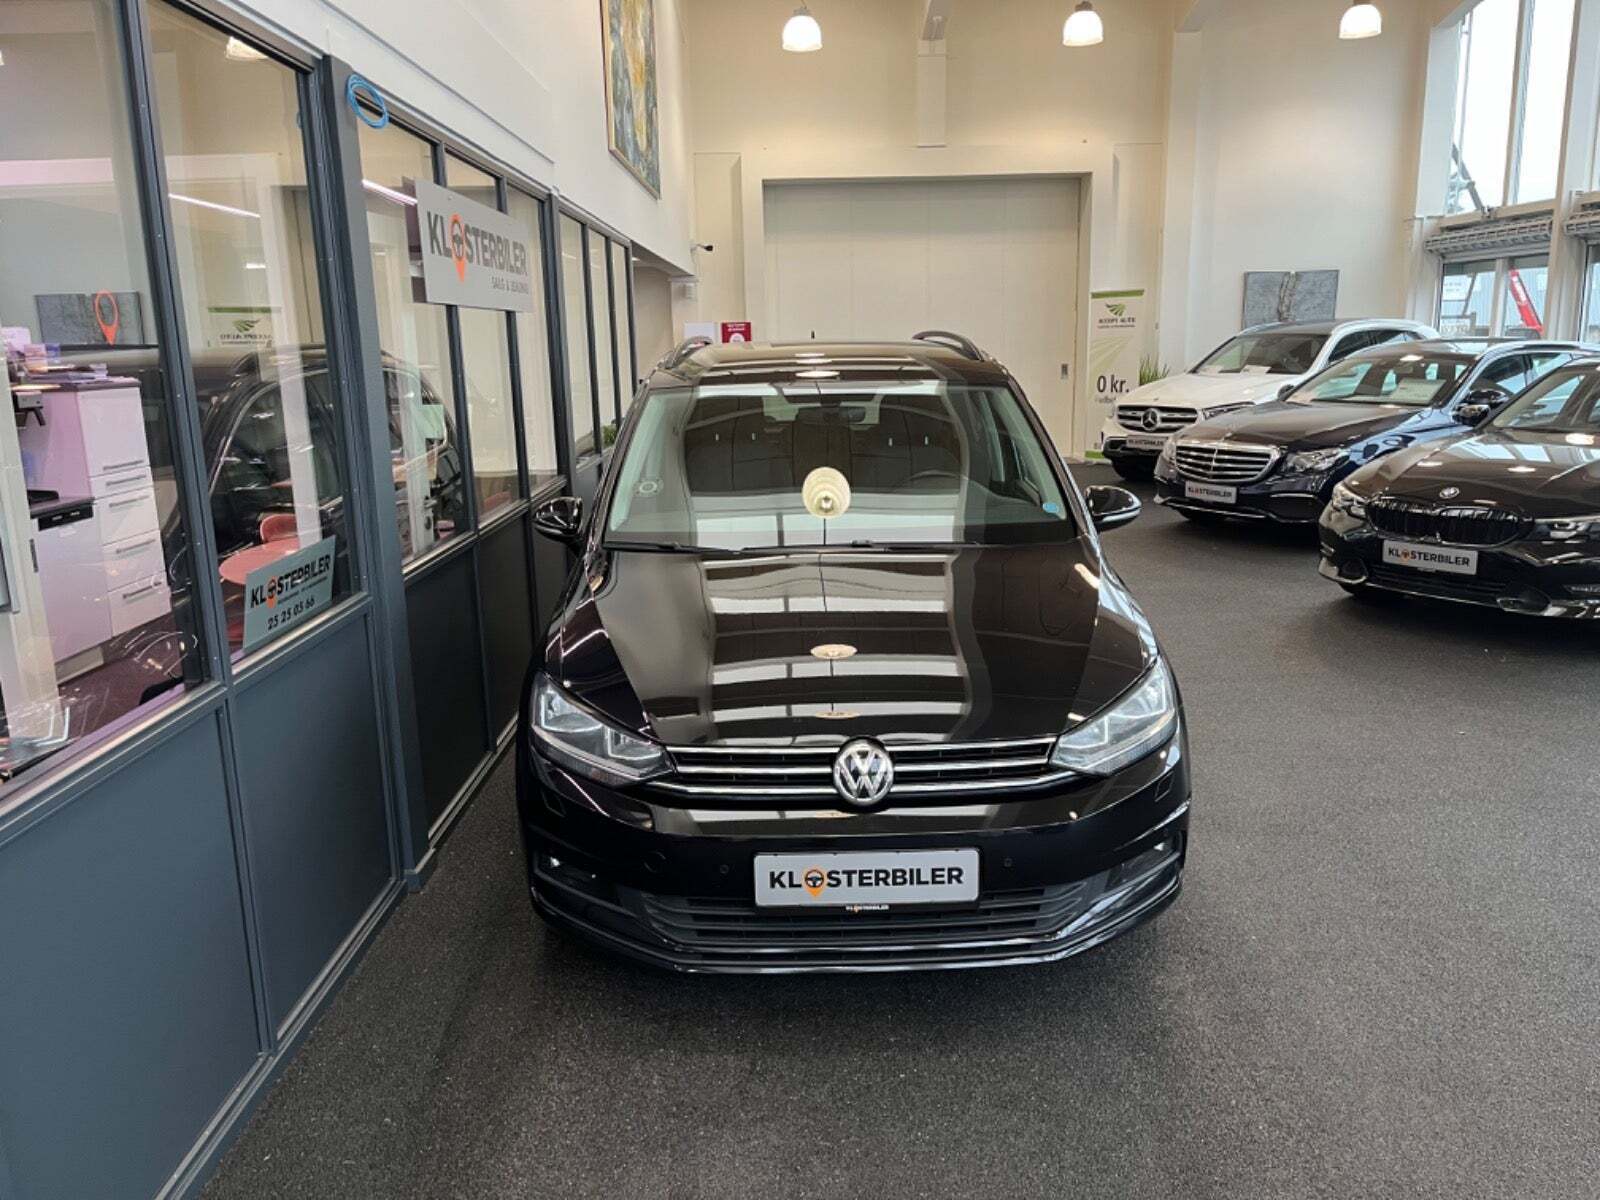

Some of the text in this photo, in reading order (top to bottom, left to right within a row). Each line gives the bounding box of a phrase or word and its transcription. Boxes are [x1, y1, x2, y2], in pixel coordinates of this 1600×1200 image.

[427, 210, 528, 276] KLOSTERBILER
[1097, 374, 1129, 393] 0 kr.
[1388, 547, 1470, 567] KLOSTERBILER
[250, 554, 331, 608] KLOSTERBILER
[267, 614, 279, 630] 25
[280, 607, 292, 623] 25
[769, 866, 964, 891] KLOSTERBILER
